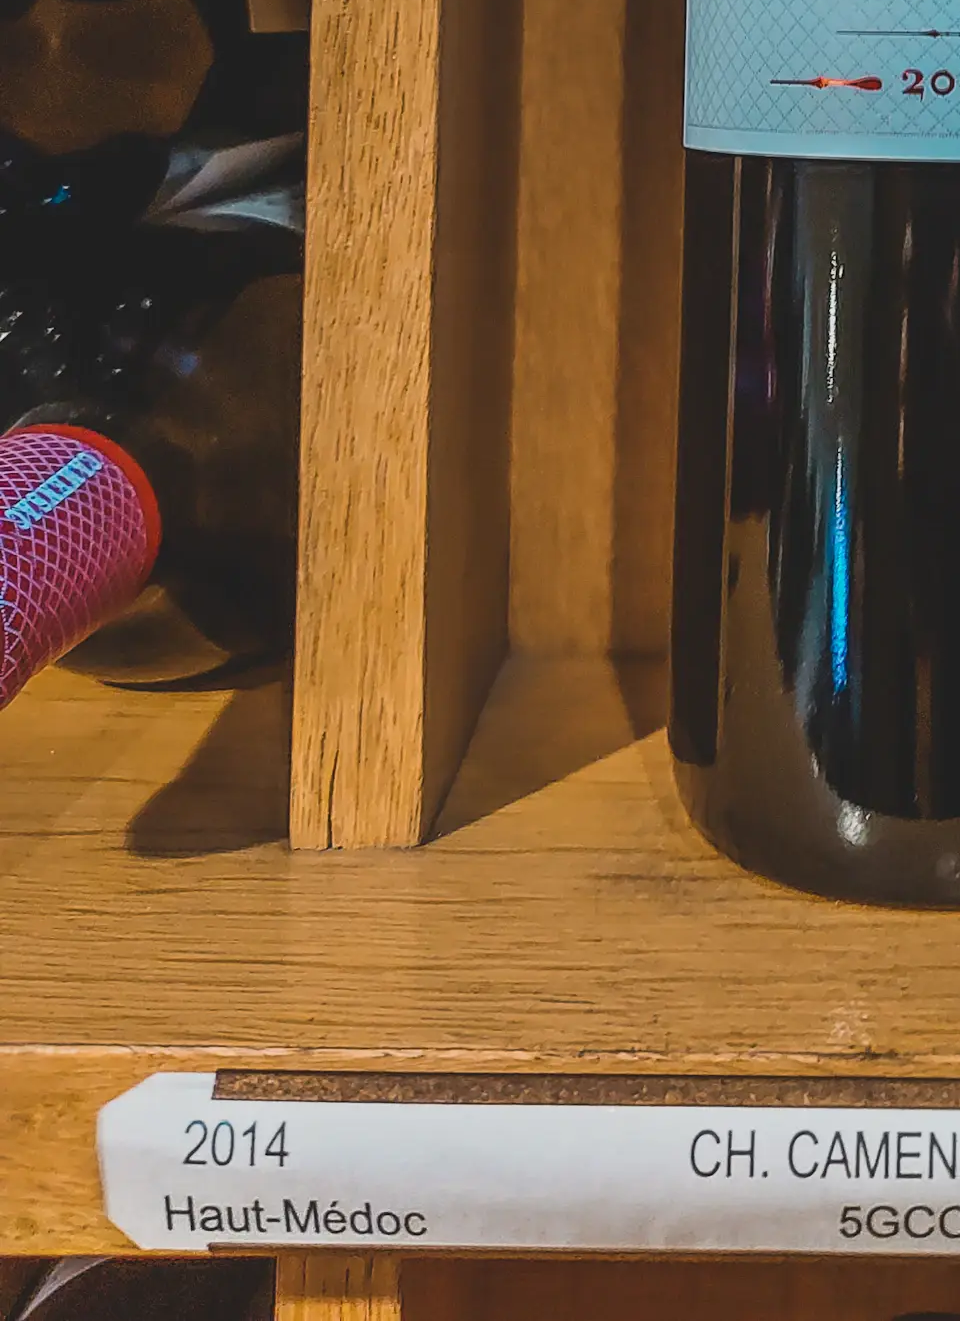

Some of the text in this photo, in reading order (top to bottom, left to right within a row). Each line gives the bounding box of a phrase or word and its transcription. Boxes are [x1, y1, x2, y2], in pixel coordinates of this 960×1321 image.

[183, 1120, 290, 1168] 2014
[690, 1129, 770, 1179] CH.
[164, 1194, 428, 1236] Haut-Médoc
